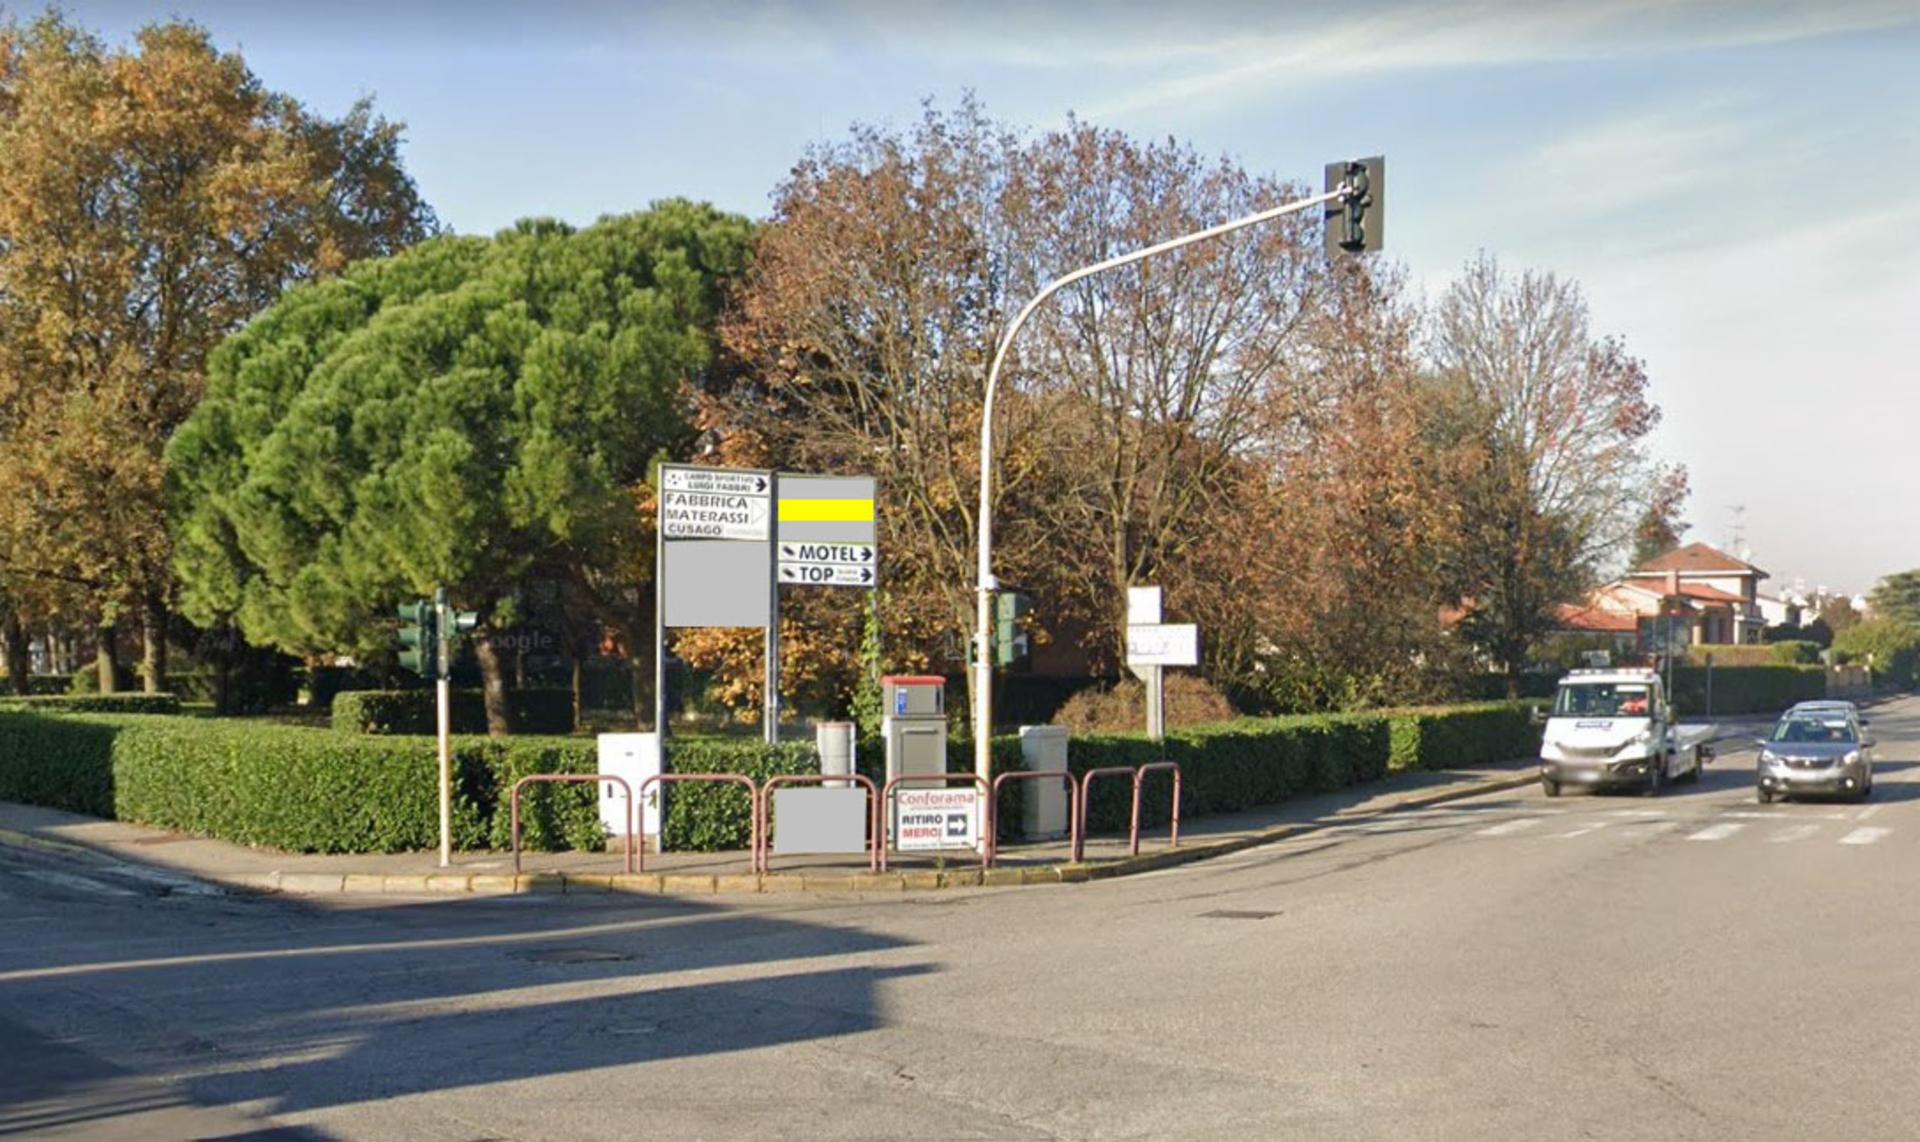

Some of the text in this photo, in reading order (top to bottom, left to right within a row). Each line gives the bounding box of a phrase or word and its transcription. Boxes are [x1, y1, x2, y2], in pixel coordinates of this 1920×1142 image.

[684, 473, 755, 483] CAMPO SPORTIVO
[688, 482, 751, 492] LUIGI FABBRI
[666, 493, 748, 509] FABBRICA
[666, 509, 749, 523] MATERASSI
[668, 523, 722, 535] CUSAGO
[799, 544, 858, 562] MOTEL
[799, 566, 834, 582] TOP
[898, 792, 975, 805] Conforama
[903, 814, 943, 825] RITIRO
